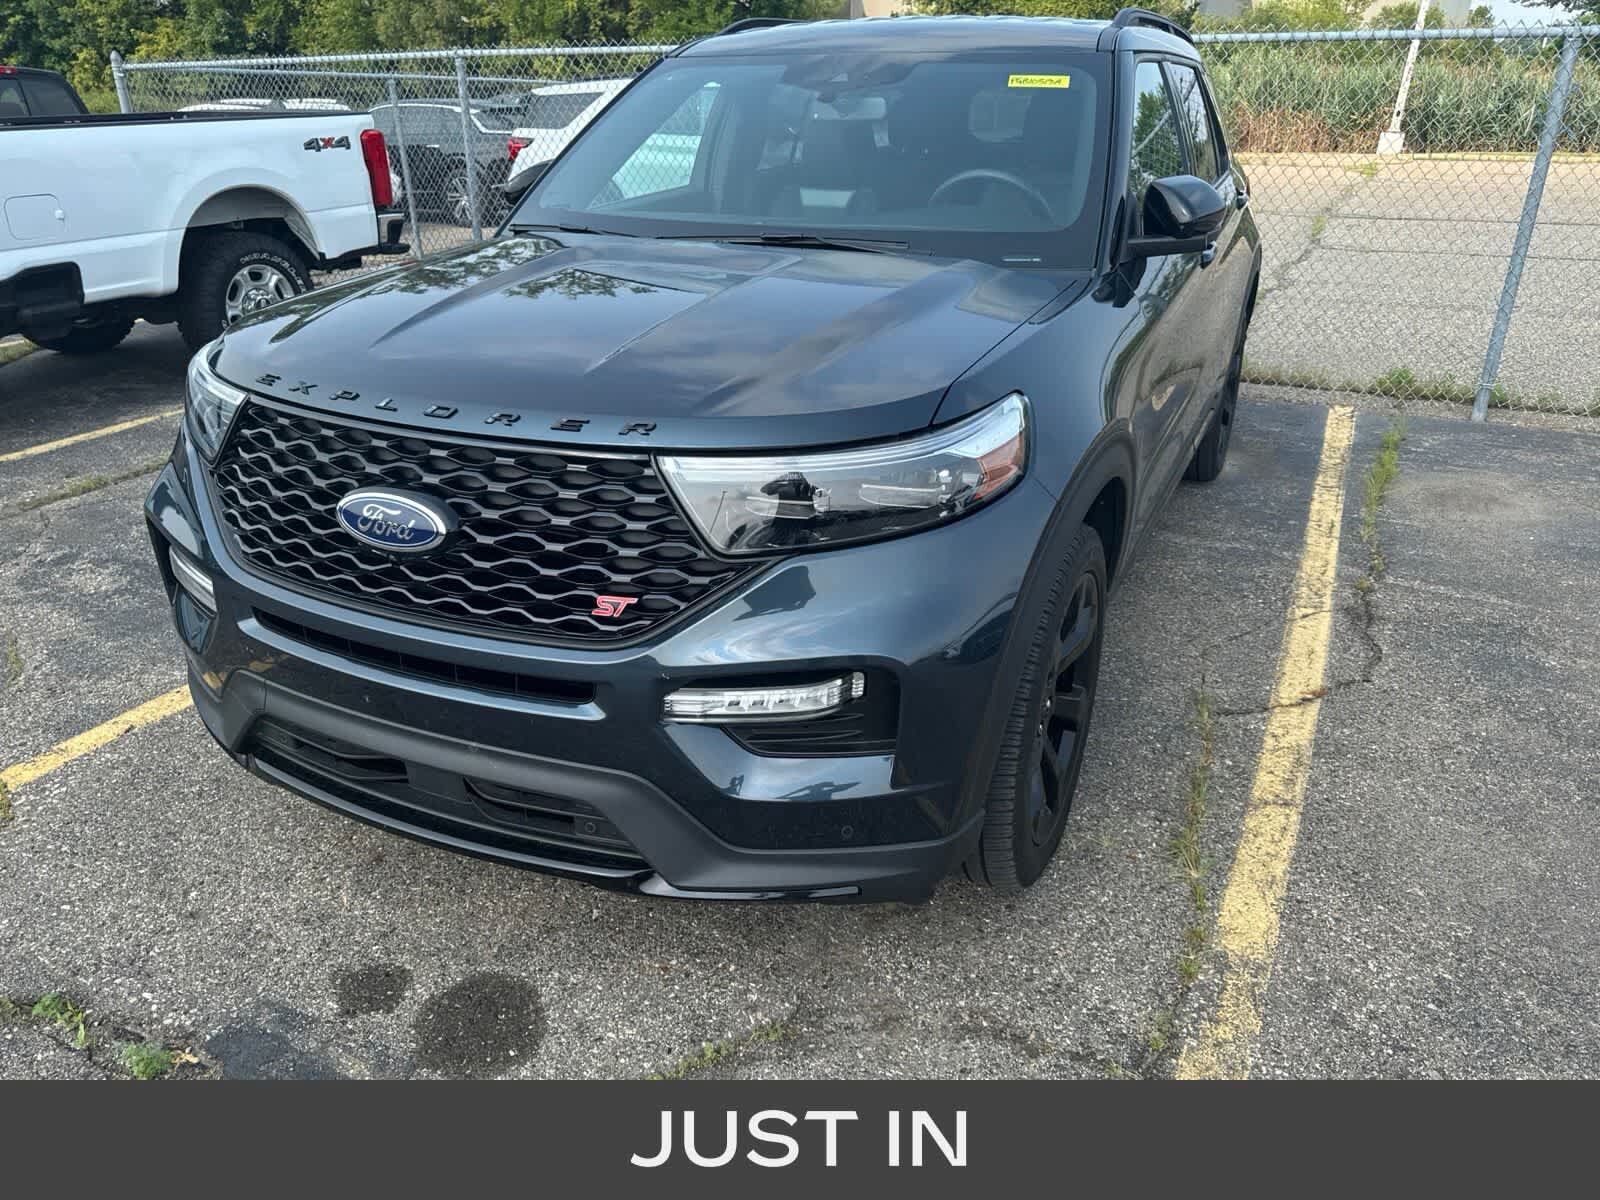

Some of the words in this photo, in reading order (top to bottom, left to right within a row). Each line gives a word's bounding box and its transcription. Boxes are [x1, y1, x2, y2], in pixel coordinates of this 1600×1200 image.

[255, 373, 658, 437] EXPLORER
[357, 503, 415, 540] Ford
[592, 595, 638, 617] ST
